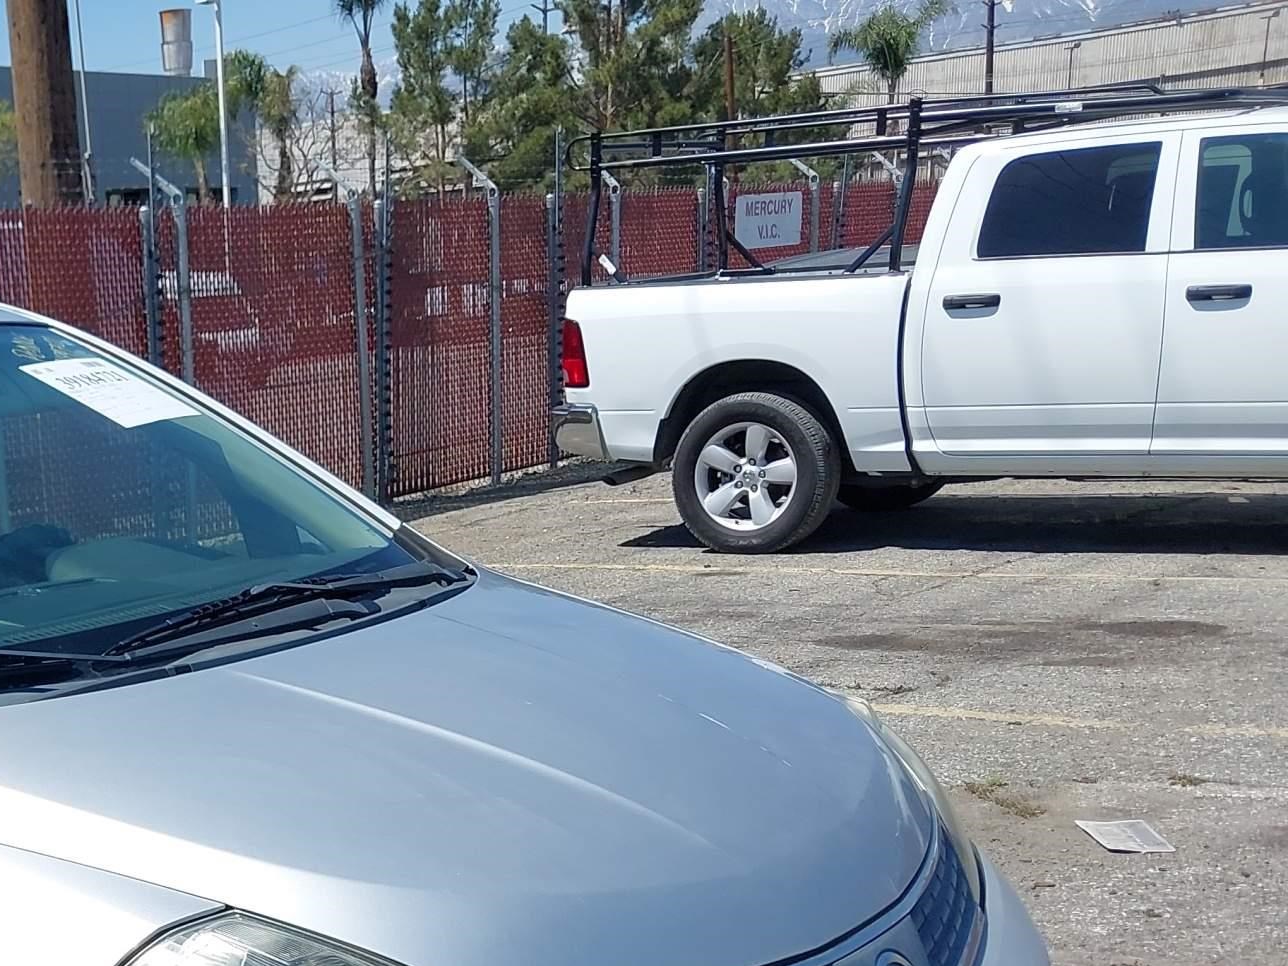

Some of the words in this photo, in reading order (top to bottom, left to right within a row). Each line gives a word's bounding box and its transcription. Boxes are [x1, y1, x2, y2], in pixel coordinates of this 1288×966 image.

[745, 198, 794, 217] MERCURY
[757, 224, 781, 240] V.I.C.
[55, 370, 129, 390] 39184721
